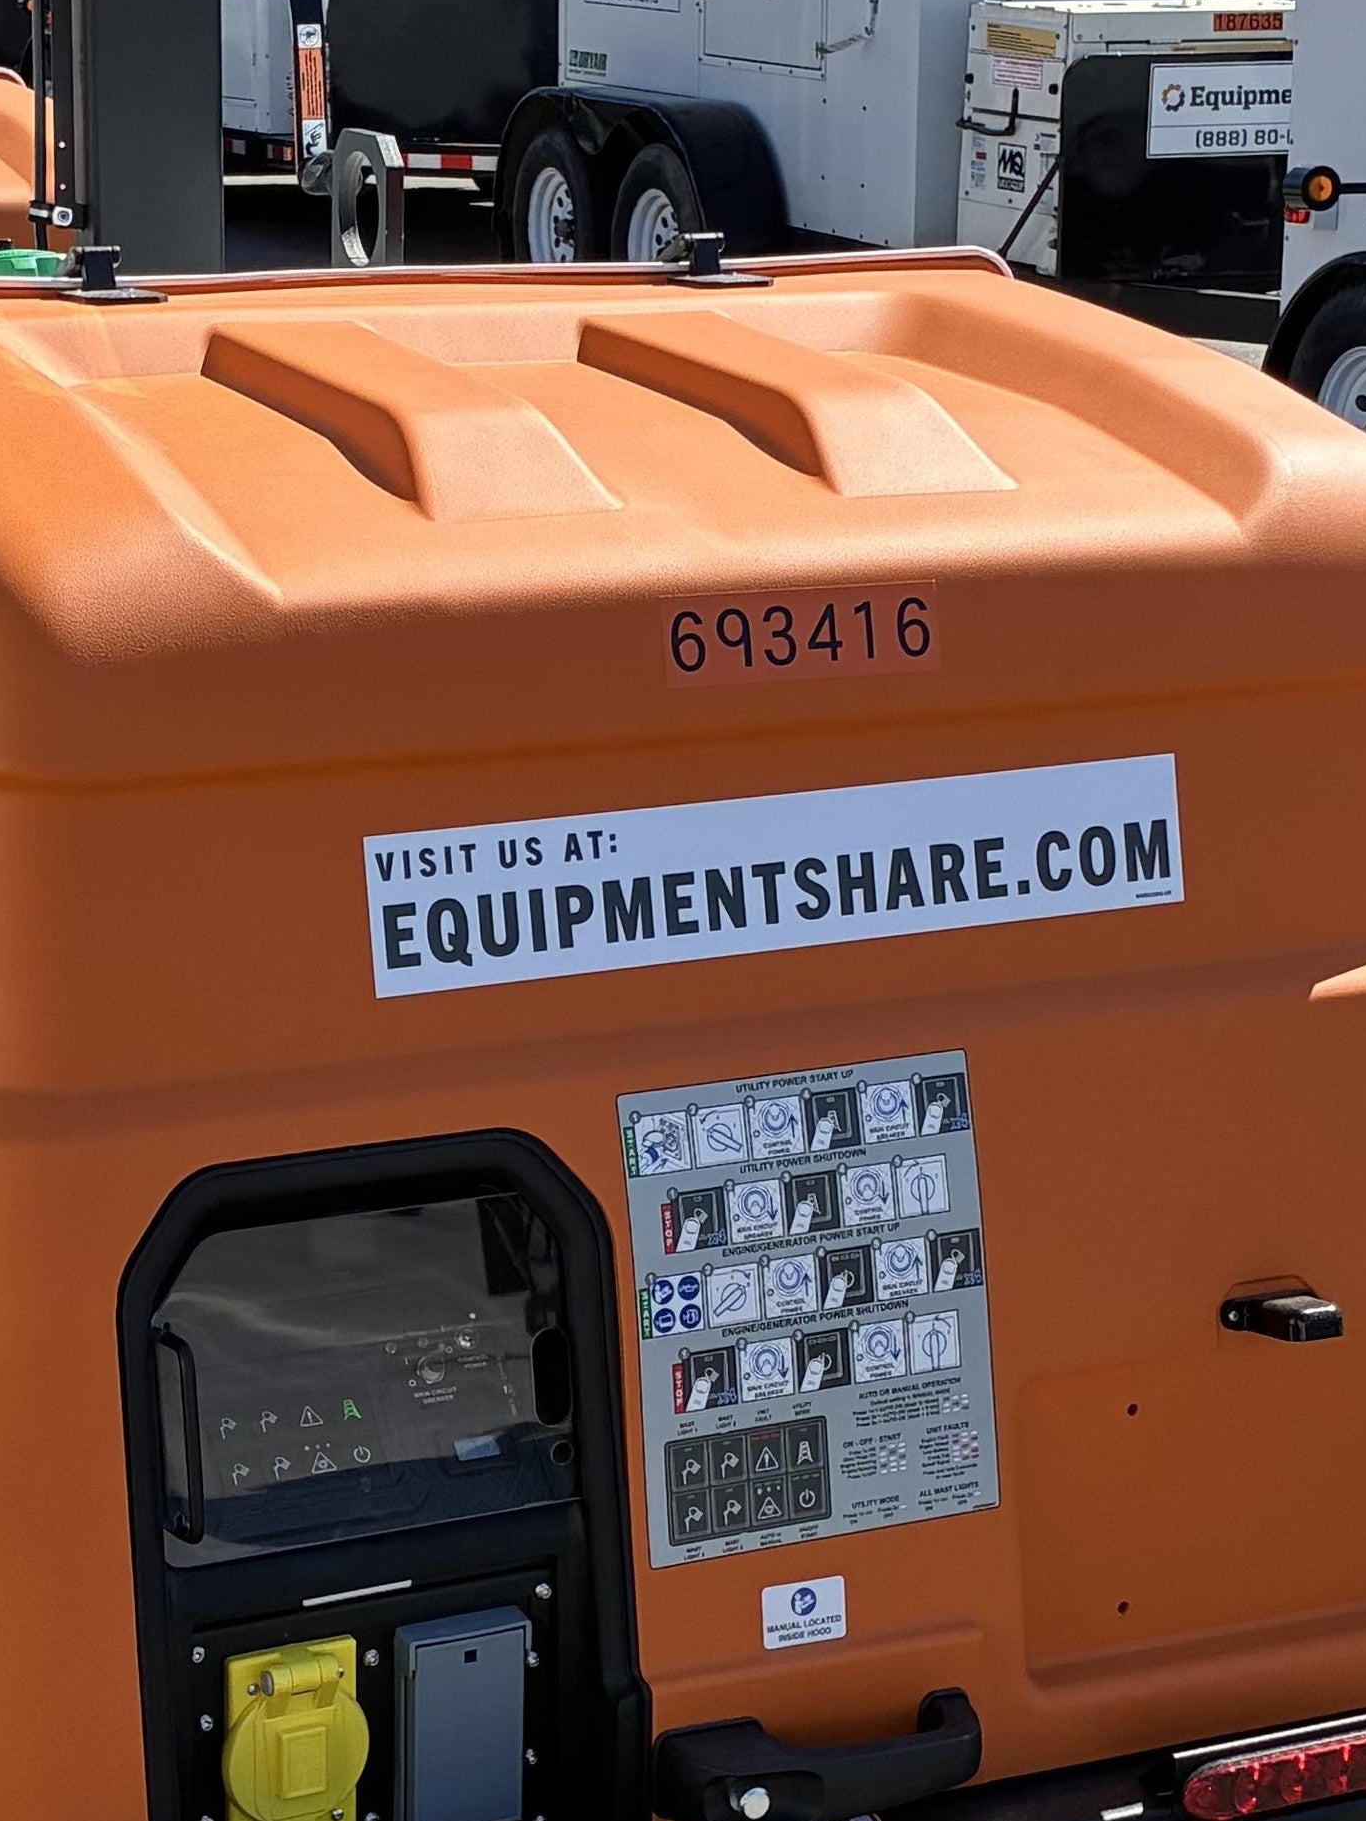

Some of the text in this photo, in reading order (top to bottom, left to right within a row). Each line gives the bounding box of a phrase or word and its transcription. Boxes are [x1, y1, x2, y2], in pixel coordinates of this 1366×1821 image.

[1216, 13, 1283, 31] 187635
[1189, 85, 1292, 111] Equipme
[1195, 129, 1248, 148] (888)
[669, 596, 932, 672] 693416
[374, 830, 619, 883] VISIT US AT:
[381, 819, 1173, 971] EQUIPMENTSHARE.COM
[736, 1069, 854, 1094] UTILITY POWER START UP
[740, 1148, 867, 1175] UTILITY POWER SHUTDOWN
[819, 1230, 854, 1243] POWER
[855, 1225, 885, 1237] START
[887, 1222, 900, 1232] UP
[819, 1309, 854, 1322] POWER
[856, 1300, 909, 1315] SHUTDOWN
[767, 1614, 842, 1634] MANUAL LOCATED
[778, 1626, 832, 1642] INSIDE HOOD
